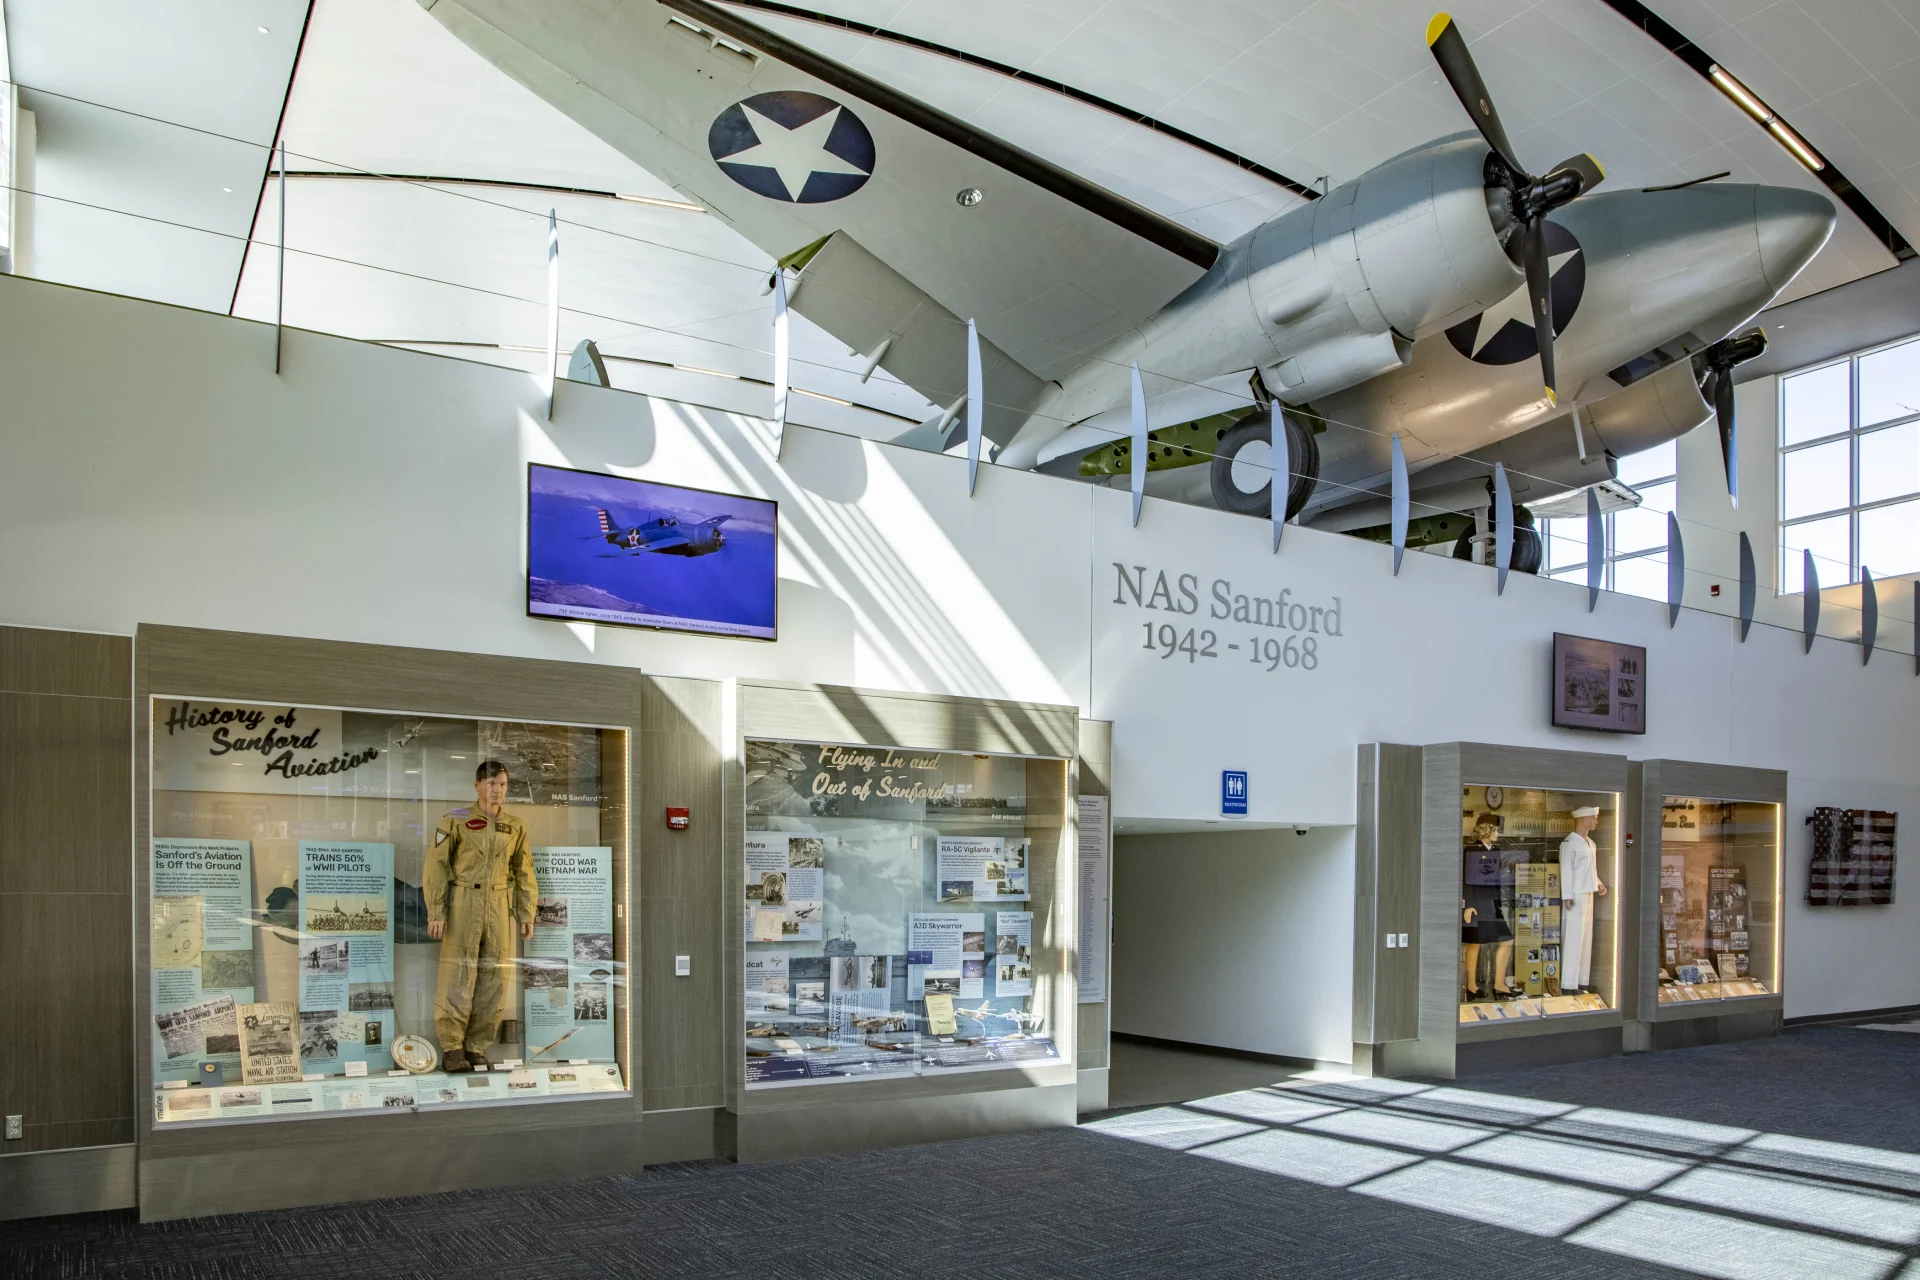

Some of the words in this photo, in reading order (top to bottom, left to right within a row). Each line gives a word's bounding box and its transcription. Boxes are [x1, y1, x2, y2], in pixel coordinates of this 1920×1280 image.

[1112, 562, 1198, 615] NAS
[1210, 579, 1343, 637] Sanford
[1142, 621, 1218, 663] 1942
[1250, 635, 1319, 672] 1968
[164, 702, 265, 735] History
[274, 708, 296, 728] of
[209, 727, 321, 756] Sanford
[264, 747, 378, 779] Aviation
[818, 744, 876, 772] Flying
[881, 749, 906, 769] In
[910, 752, 941, 770] and
[812, 772, 847, 795] Out
[852, 778, 873, 801] of
[876, 776, 947, 804] Sanford
[552, 793, 568, 801] NAS
[568, 794, 598, 802] Sanford
[155, 850, 202, 860] Sanford's
[204, 852, 242, 860] Aviation
[941, 845, 962, 853] RA-5C
[963, 846, 990, 854] Vigilante
[306, 854, 342, 862] TRAINS
[344, 854, 365, 863] 50%
[551, 858, 575, 866] COLD
[577, 858, 597, 866] WAR
[156, 861, 164, 869] Is
[167, 860, 183, 869] Off
[185, 861, 202, 869] the
[205, 862, 241, 870] Ground
[338, 864, 371, 872] PILOTS
[928, 923, 962, 931] Skywarrior
[189, 1011, 211, 1023] SANFORD
[251, 1058, 272, 1067] UNITED
[273, 1056, 292, 1065] STATES
[247, 1068, 263, 1077] NAVAL
[265, 1067, 274, 1076] AIR
[276, 1065, 298, 1075] STATION
